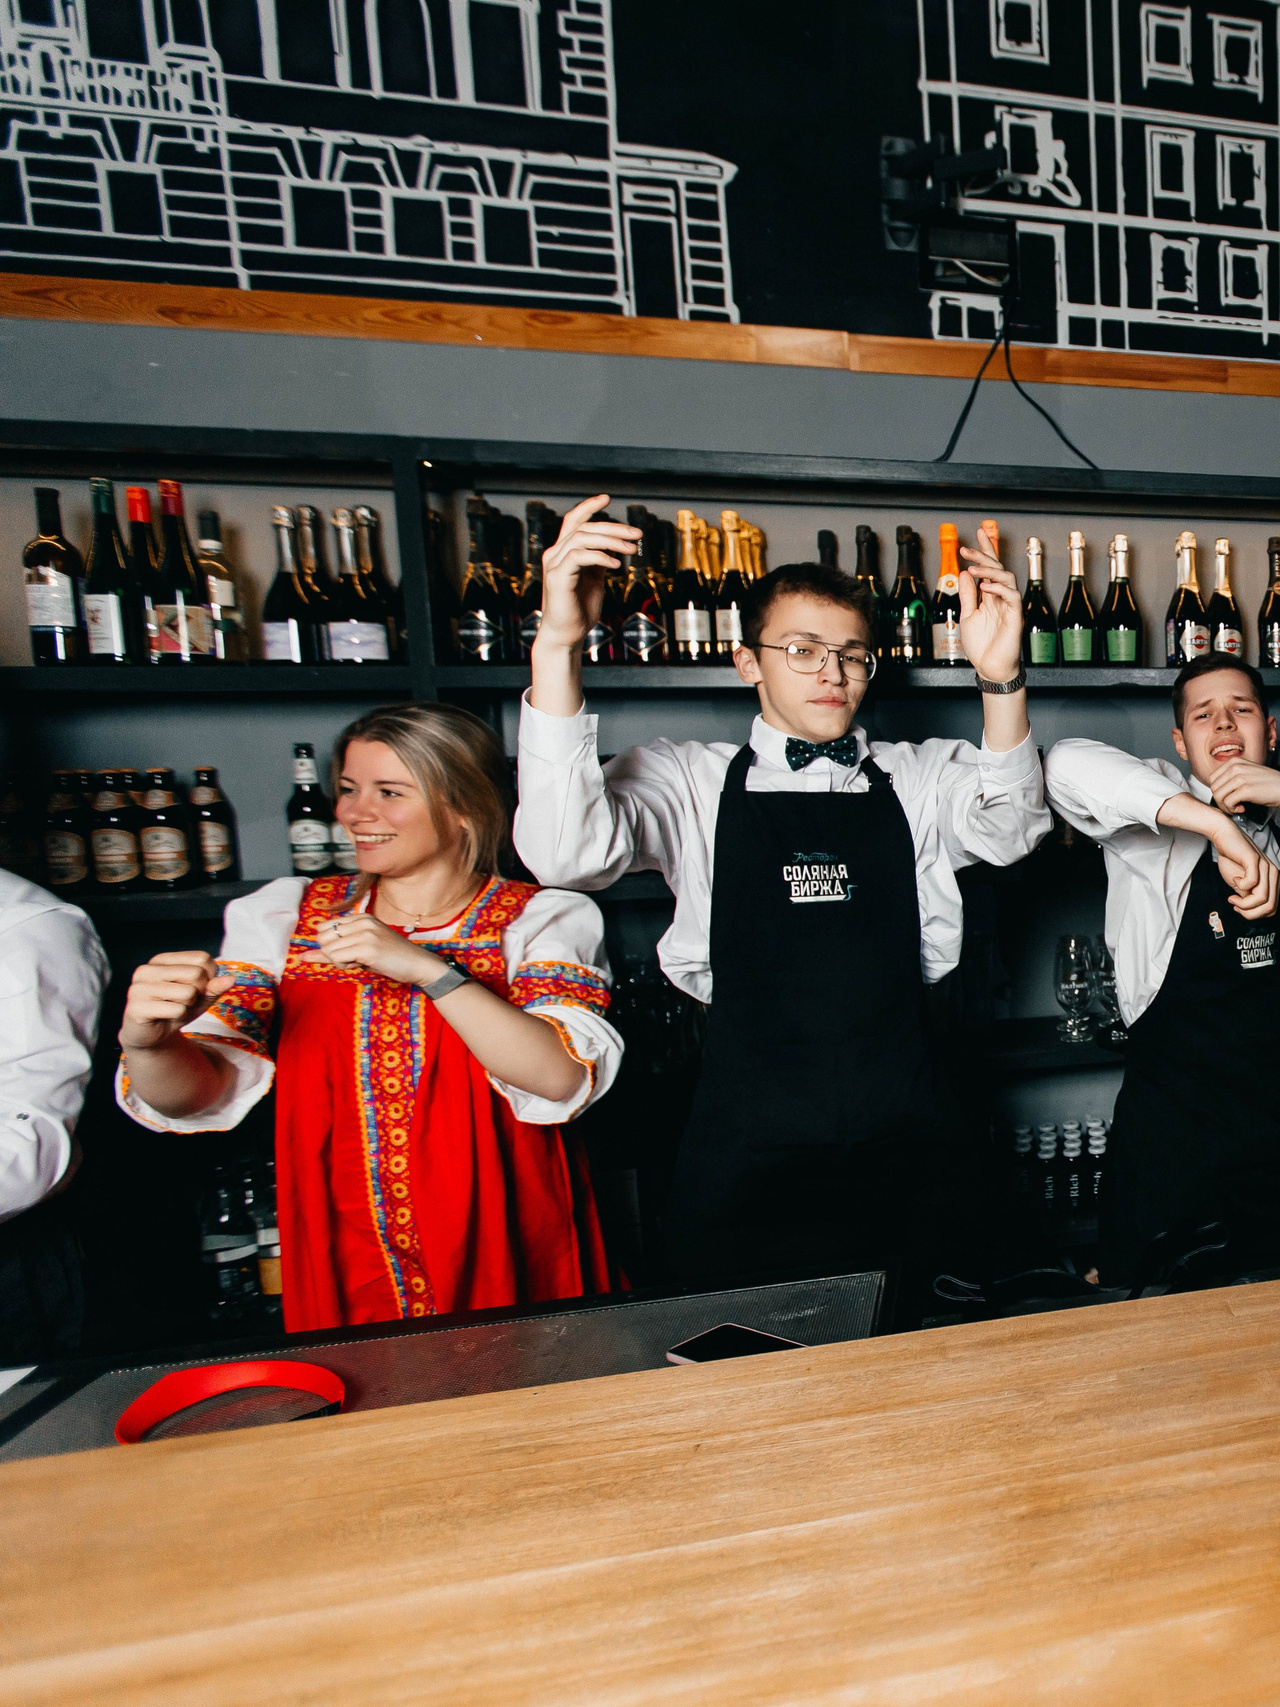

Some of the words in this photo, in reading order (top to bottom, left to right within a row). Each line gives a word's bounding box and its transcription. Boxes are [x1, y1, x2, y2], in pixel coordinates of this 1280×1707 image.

[1186, 637, 1209, 646] MARTI
[783, 864, 848, 881] СОЛЯНАЯ
[791, 880, 844, 896] БИРЖА
[1236, 932, 1276, 950] СОЛЯНАЯ
[1241, 946, 1272, 963] БИРЖА
[1045, 1176, 1054, 1199] Rich
[1070, 1174, 1080, 1197] Rich
